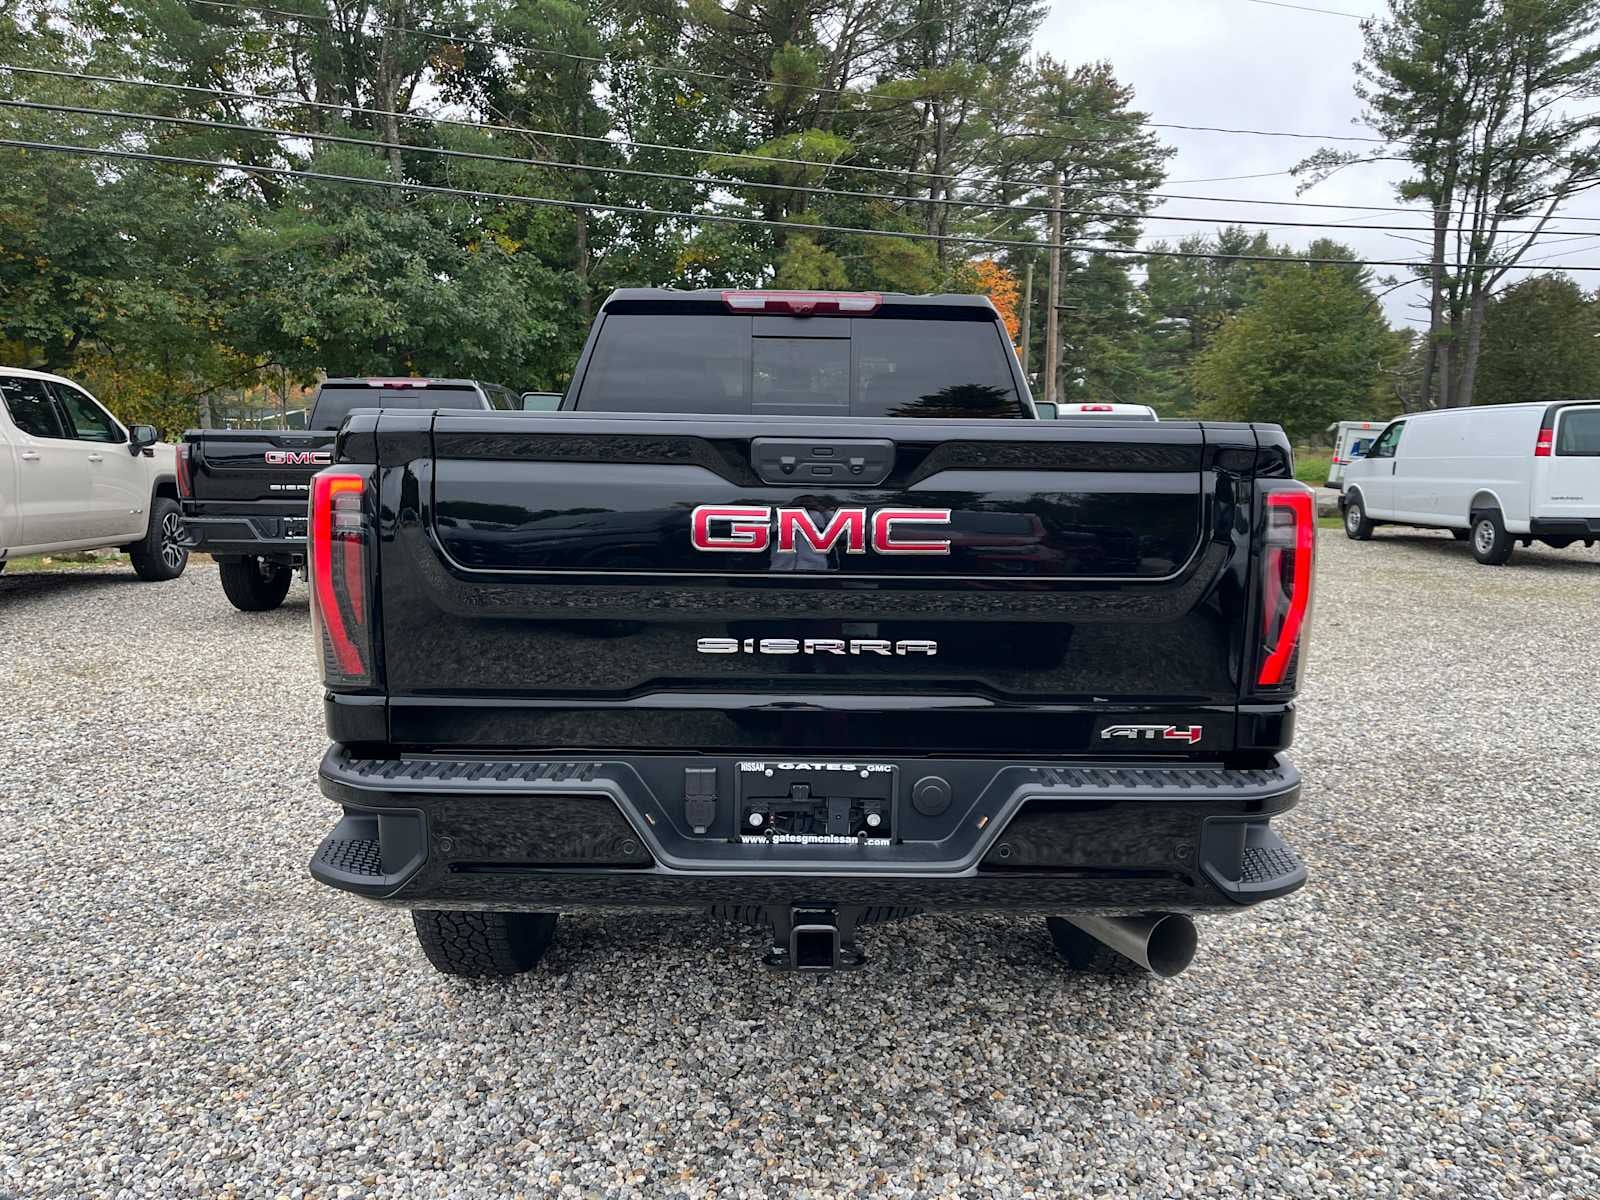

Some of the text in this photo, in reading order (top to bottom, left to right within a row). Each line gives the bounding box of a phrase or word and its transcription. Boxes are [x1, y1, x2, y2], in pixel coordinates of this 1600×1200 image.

[265, 451, 331, 464] GMC
[691, 505, 952, 555] GMC
[697, 638, 938, 656] SIERRA
[1101, 725, 1203, 744] AT4
[741, 762, 892, 773] NISSAN GATES GMC
